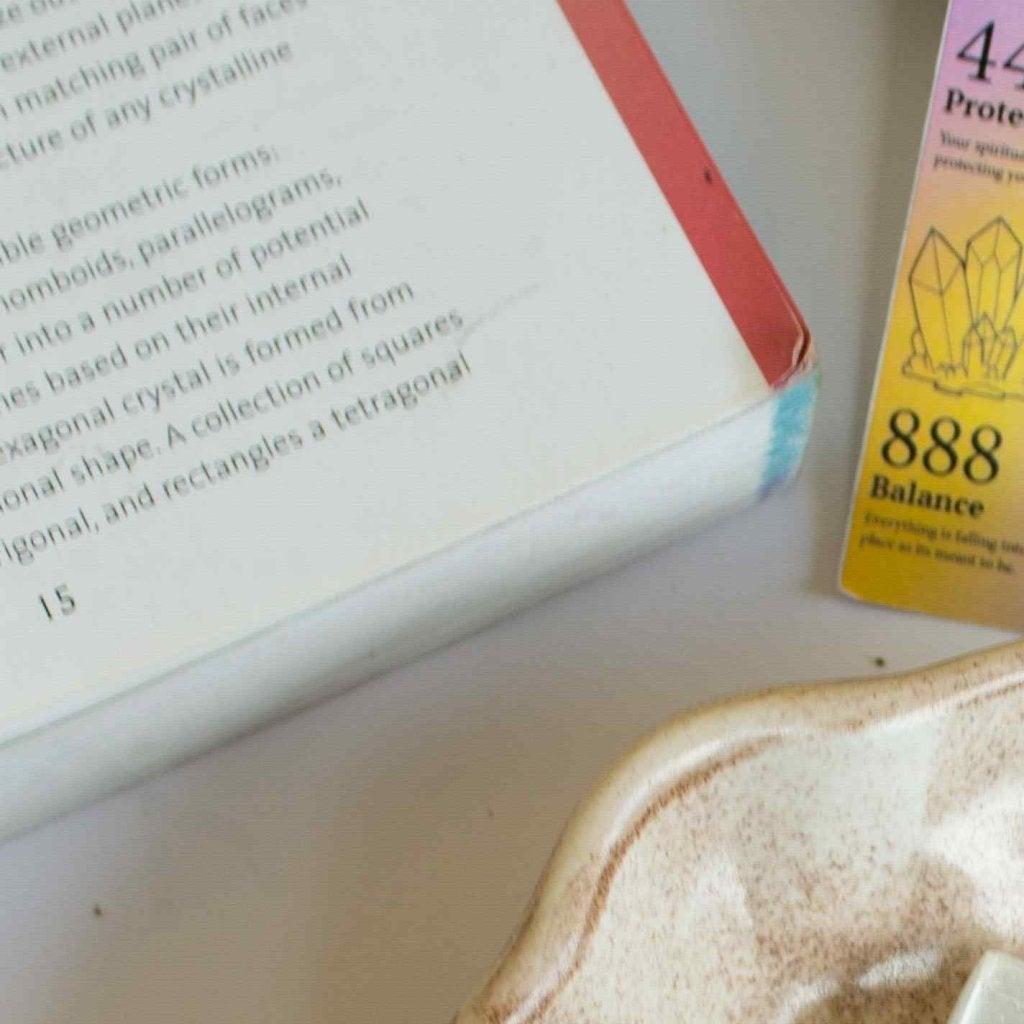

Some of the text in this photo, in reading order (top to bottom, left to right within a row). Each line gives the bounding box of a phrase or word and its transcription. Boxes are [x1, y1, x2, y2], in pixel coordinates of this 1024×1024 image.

[0, 42, 292, 169] ture of any crystalline
[14, 53, 146, 114] matching
[149, 30, 198, 71] pair
[206, 11, 232, 41] of
[933, 154, 1004, 184] protecting
[940, 129, 971, 151] Your
[0, 233, 43, 266] ble
[51, 179, 187, 250] geometric
[137, 169, 341, 268] parallelograms,
[15, 321, 72, 356] into
[81, 313, 95, 331] a
[102, 268, 206, 323] number
[215, 247, 242, 279] of
[250, 197, 369, 271] potential
[44, 342, 128, 394] based
[135, 333, 170, 360] on
[174, 304, 238, 343] their
[246, 253, 352, 315] internal
[121, 360, 211, 414] crystal
[215, 355, 240, 377] is
[244, 307, 343, 365] formed
[348, 283, 414, 322] from
[0, 310, 463, 513] onal shape. A collection of squares
[106, 483, 155, 524] and
[162, 430, 303, 500] rectangles
[309, 421, 326, 441] a
[330, 350, 470, 431] tetragonal
[881, 409, 1003, 484] 888
[864, 509, 938, 543] Everything
[954, 530, 998, 555] falling
[870, 474, 984, 519] Balance
[39, 585, 76, 620] 15
